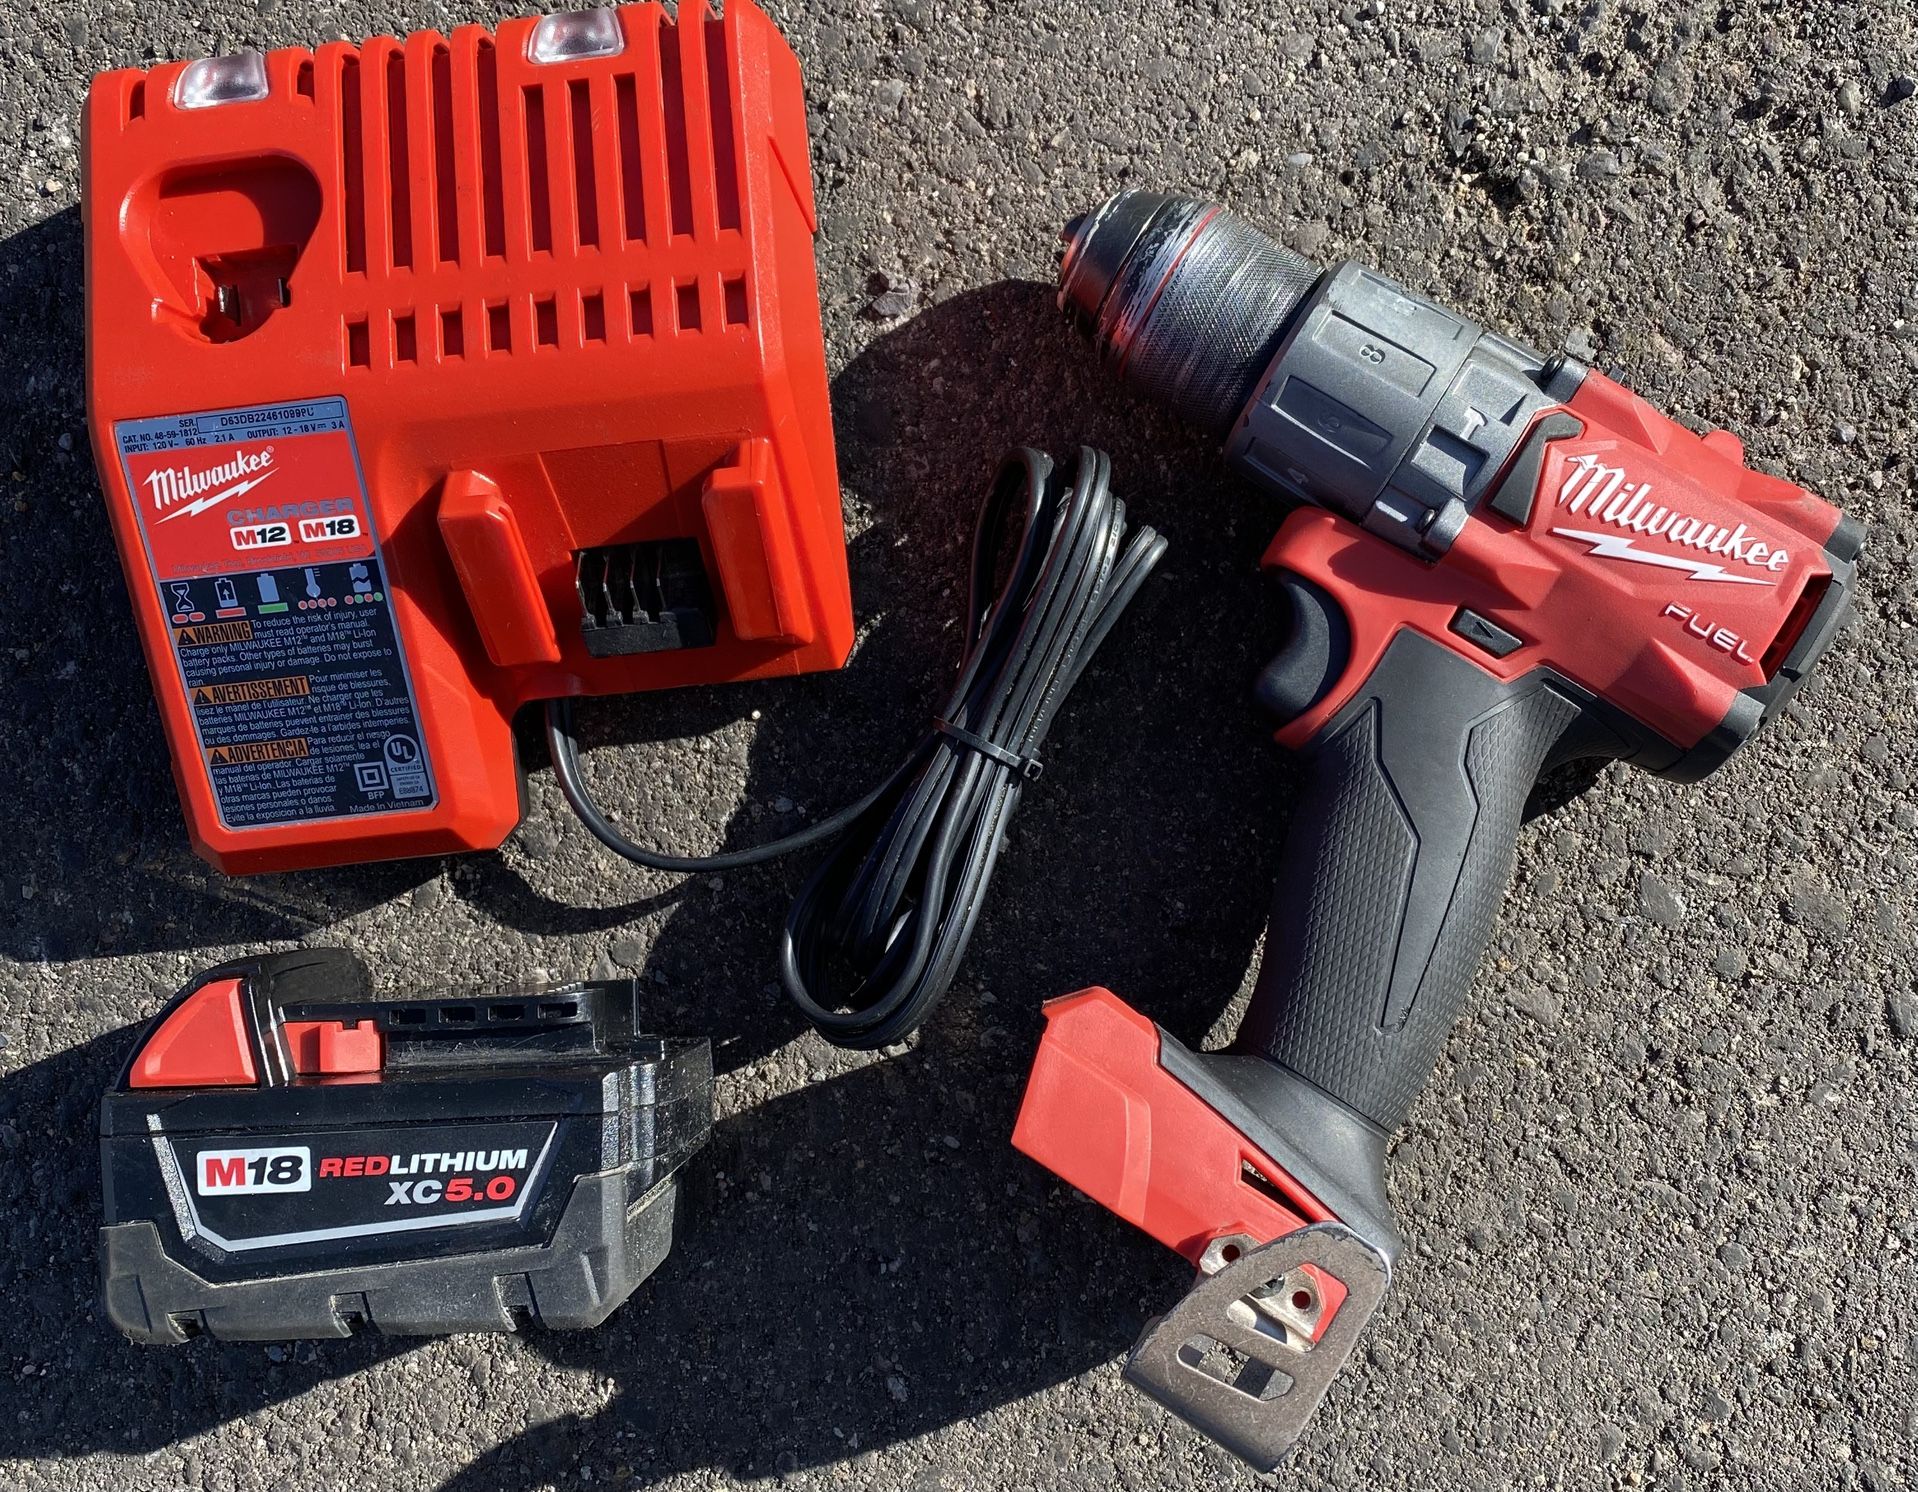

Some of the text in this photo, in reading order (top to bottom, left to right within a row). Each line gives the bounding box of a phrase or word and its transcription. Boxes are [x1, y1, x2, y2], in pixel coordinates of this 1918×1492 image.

[121, 427, 198, 443] CAT. NO. 48-59-1812
[124, 443, 149, 452] INPUT:
[152, 441, 167, 449] 120
[184, 437, 197, 446] 60
[196, 436, 207, 444] Hz
[214, 434, 226, 442] 2.1
[226, 433, 234, 441] A
[246, 427, 279, 439] OUTPUT:
[282, 426, 292, 435] 12
[299, 424, 310, 432] 18
[330, 421, 337, 429] 3
[337, 420, 345, 428] A
[226, 497, 354, 525] CHARGER
[1554, 453, 1790, 573] Milwaukee
[250, 608, 377, 628] To reduce the risk of injury, user
[192, 621, 251, 644] WARNING
[253, 629, 274, 639] must
[275, 626, 294, 636] read
[1663, 602, 1754, 664] FUEL
[179, 645, 210, 658] Charge
[210, 643, 229, 655] only
[228, 637, 282, 652] MILWAUKEE
[309, 633, 326, 643] and
[182, 656, 211, 669] battery
[238, 649, 263, 661] Other
[263, 648, 286, 659] types
[286, 646, 296, 656] of
[297, 642, 332, 655] batteries
[332, 641, 351, 652] may
[351, 638, 373, 649] burst
[185, 666, 217, 679] causing
[217, 662, 252, 675] personal
[252, 659, 276, 672] injury
[323, 653, 336, 662] Do
[337, 651, 351, 660] not
[352, 649, 383, 661] expose
[383, 646, 393, 656] to
[308, 667, 382, 683] Pour minimiser les
[210, 676, 307, 703] AVERTISSEMENT
[310, 683, 336, 694] risque
[336, 682, 348, 690] de
[195, 706, 215, 716] lisez
[215, 705, 224, 714] le
[250, 701, 262, 710] de
[307, 694, 320, 704] Ne
[321, 691, 353, 704] charger
[353, 690, 370, 700] que
[370, 688, 384, 697] les
[198, 714, 233, 726] batteries
[233, 707, 286, 722] MILWAUKEE
[312, 705, 322, 713] et
[201, 724, 237, 737] marques
[236, 722, 248, 732] de
[248, 718, 283, 730] batteries
[353, 709, 370, 719] des
[371, 704, 410, 717] blessures
[215, 735, 231, 744] des
[306, 735, 328, 745] Para
[327, 733, 356, 744] reducir
[356, 731, 365, 741] el
[308, 746, 320, 755] de
[357, 741, 371, 750] lea
[371, 740, 380, 748] el
[226, 738, 306, 763] ADVERTENCIA
[391, 741, 412, 760] UL
[211, 764, 242, 775] manual
[242, 763, 255, 772] del
[294, 755, 323, 768] Cargar
[323, 751, 365, 764] solamente
[390, 764, 421, 773] CERTIFIED
[214, 775, 227, 785] las
[260, 771, 272, 780] de
[272, 764, 325, 779] MILWAUKEE
[217, 787, 224, 795] y
[275, 779, 291, 788] Las
[323, 773, 335, 783] de
[219, 785, 337, 804] otras marcas pueden provocar
[222, 802, 255, 813] lesiones
[255, 797, 299, 811] personales
[348, 801, 375, 813] Made
[385, 794, 424, 809] Vietnam
[367, 790, 385, 799] BFP
[224, 812, 246, 823] Evite
[245, 811, 255, 820] la
[304, 805, 313, 814] la
[205, 1149, 528, 1188] M18 REDLITHIUM
[383, 1176, 516, 1206] XC5.0
